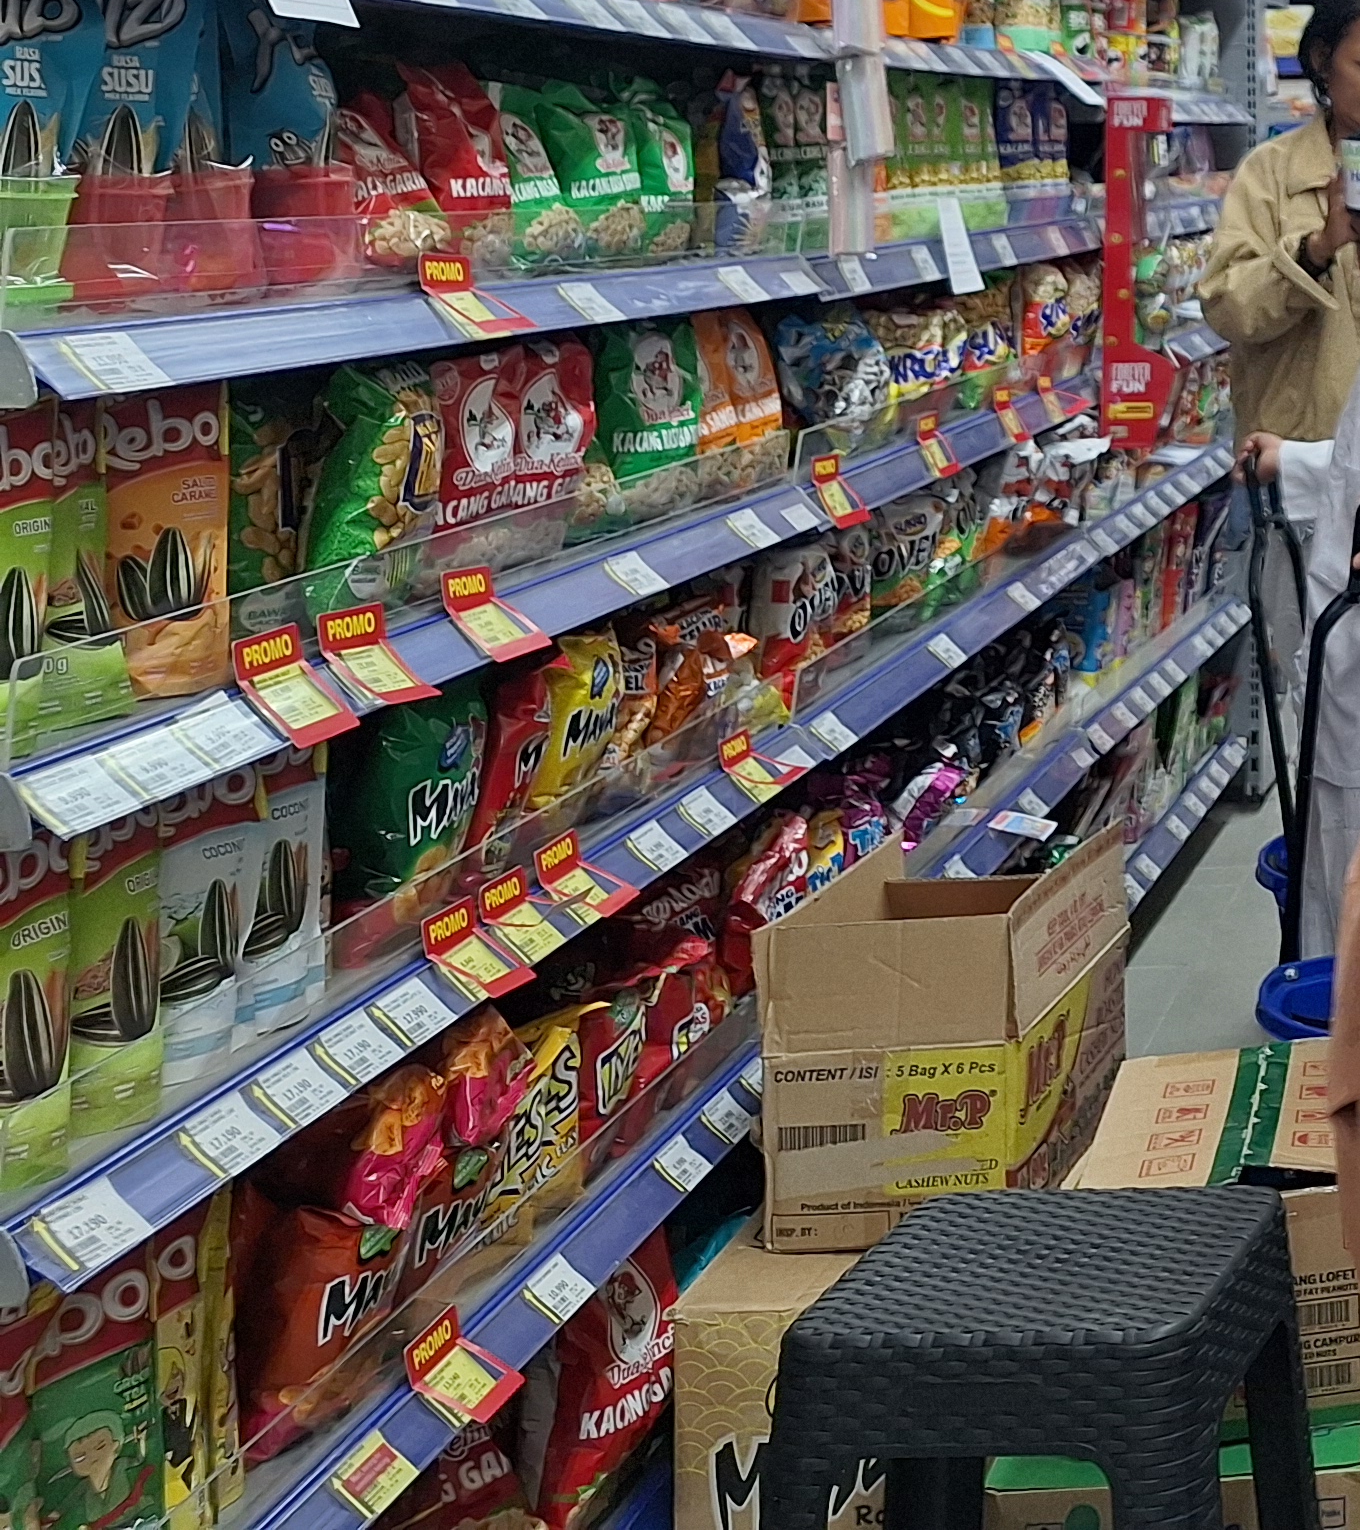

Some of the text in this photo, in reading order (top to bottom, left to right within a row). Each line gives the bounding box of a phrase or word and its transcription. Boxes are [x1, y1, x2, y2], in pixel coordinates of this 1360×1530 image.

[101, 68, 154, 94] SUSU
[425, 260, 464, 282] PROMO
[1110, 380, 1147, 395] FUN
[171, 488, 218, 505] CARAME
[433, 491, 488, 526] ACANG
[13, 516, 52, 539] ORIGIN
[448, 573, 486, 598] PROMO
[326, 611, 376, 642] PROMO
[241, 633, 293, 670] PROMO
[722, 736, 748, 761] PROMO
[271, 797, 309, 821] COCON
[202, 837, 243, 861] COCON
[541, 836, 574, 872] PROMO
[484, 875, 521, 912] PROMO
[11, 911, 69, 949] ORIGIN
[429, 906, 469, 946] PROMO
[403, 1004, 429, 1026] 17,990
[342, 1039, 371, 1061] 17,190
[774, 1067, 848, 1084] CONTENT
[858, 1066, 879, 1080] ISI
[895, 1065, 905, 1077] 5
[908, 1064, 938, 1079] Bag
[940, 1063, 953, 1076] X
[955, 1063, 965, 1075] 6
[968, 1061, 997, 1075] Pcs
[281, 1077, 312, 1103] 17,190
[891, 1089, 991, 1135] Mr.P
[209, 1124, 243, 1152] 17,190
[896, 1171, 989, 1190] CASHEW NUTS
[801, 1201, 839, 1213] Product
[413, 1318, 452, 1371] PROMO
